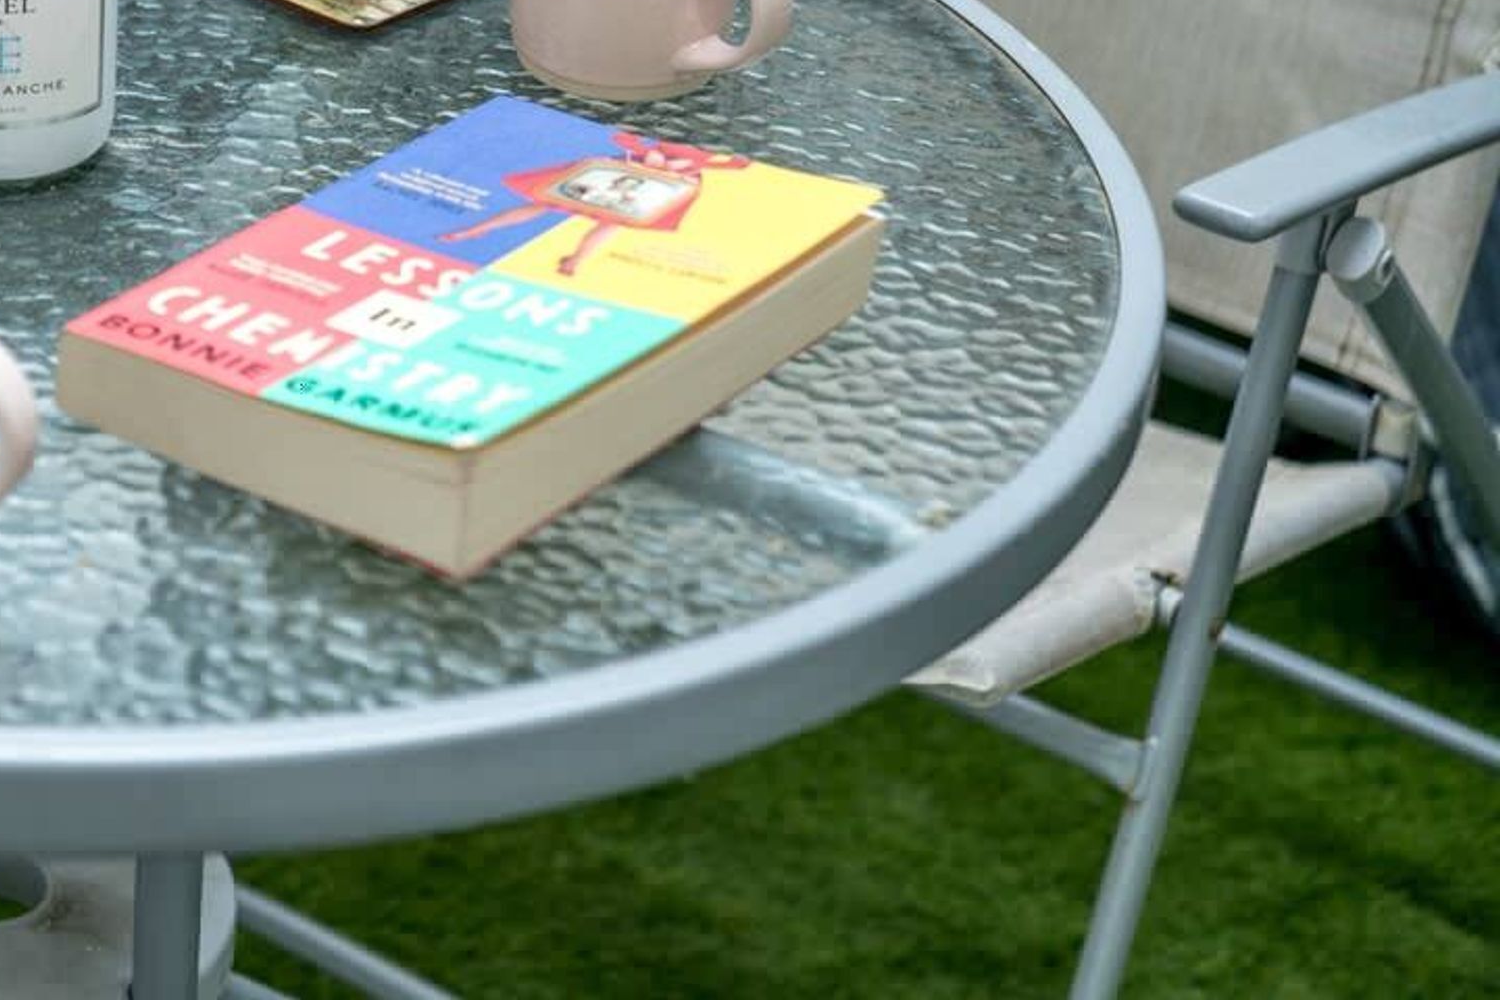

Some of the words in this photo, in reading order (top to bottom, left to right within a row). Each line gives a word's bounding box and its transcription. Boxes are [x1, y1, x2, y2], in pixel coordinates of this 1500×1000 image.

[301, 229, 612, 336] LESSONS
[99, 313, 273, 380] BONNIE
[285, 376, 480, 433] GARMUS
[147, 285, 532, 414] CHEMISTRY
